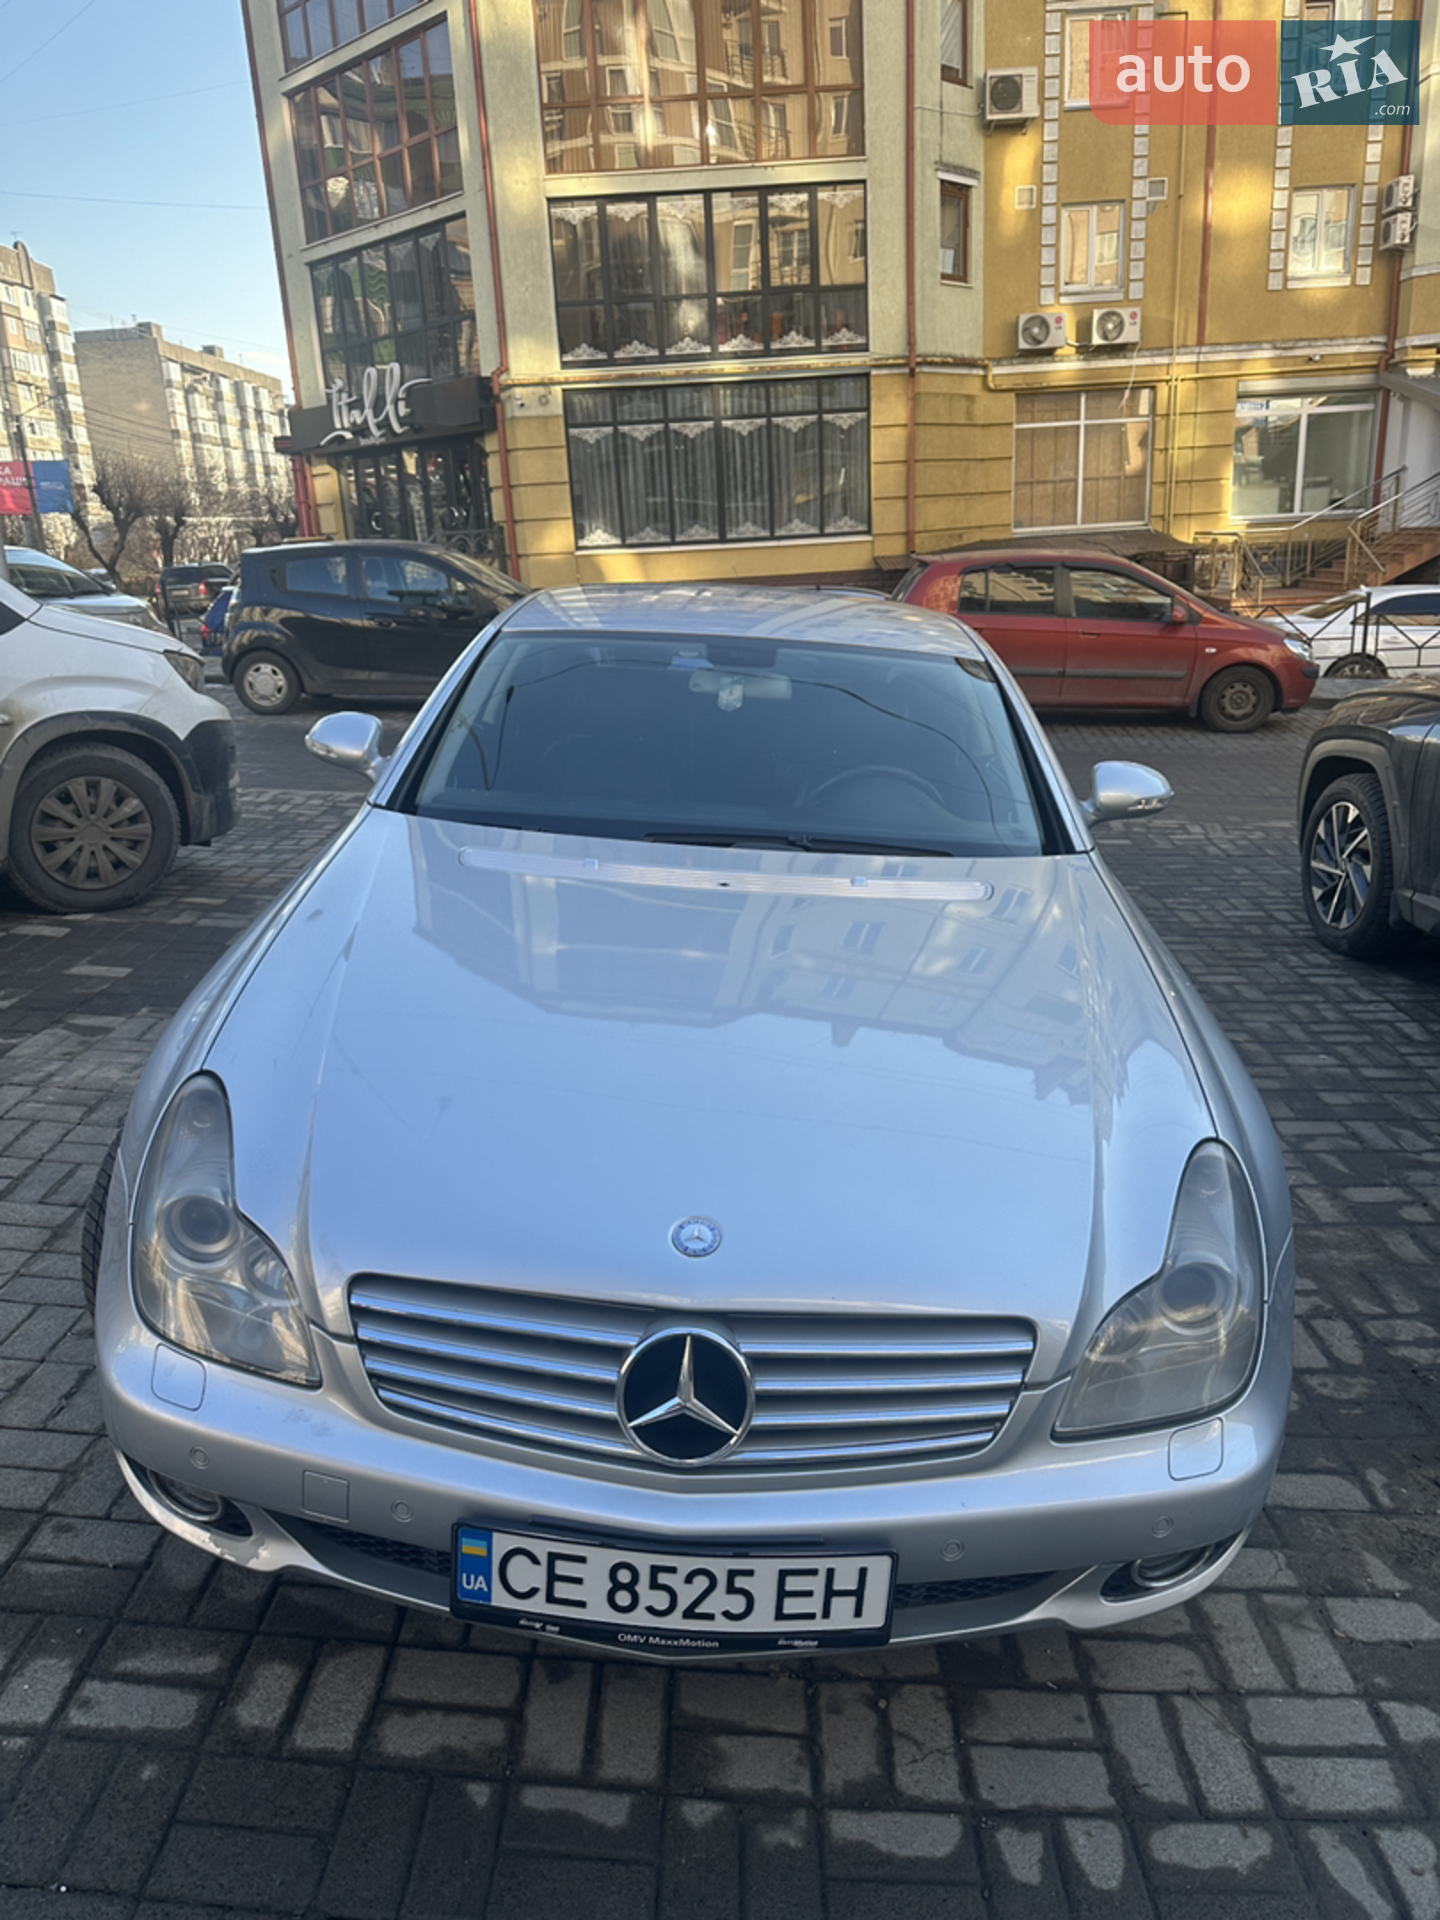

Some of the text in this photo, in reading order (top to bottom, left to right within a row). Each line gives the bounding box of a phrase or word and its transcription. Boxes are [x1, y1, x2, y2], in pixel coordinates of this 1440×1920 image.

[463, 1573, 487, 1592] UA
[498, 1546, 868, 1622] CE 8525 EH
[618, 1633, 719, 1647] OMV MaxxMotion
